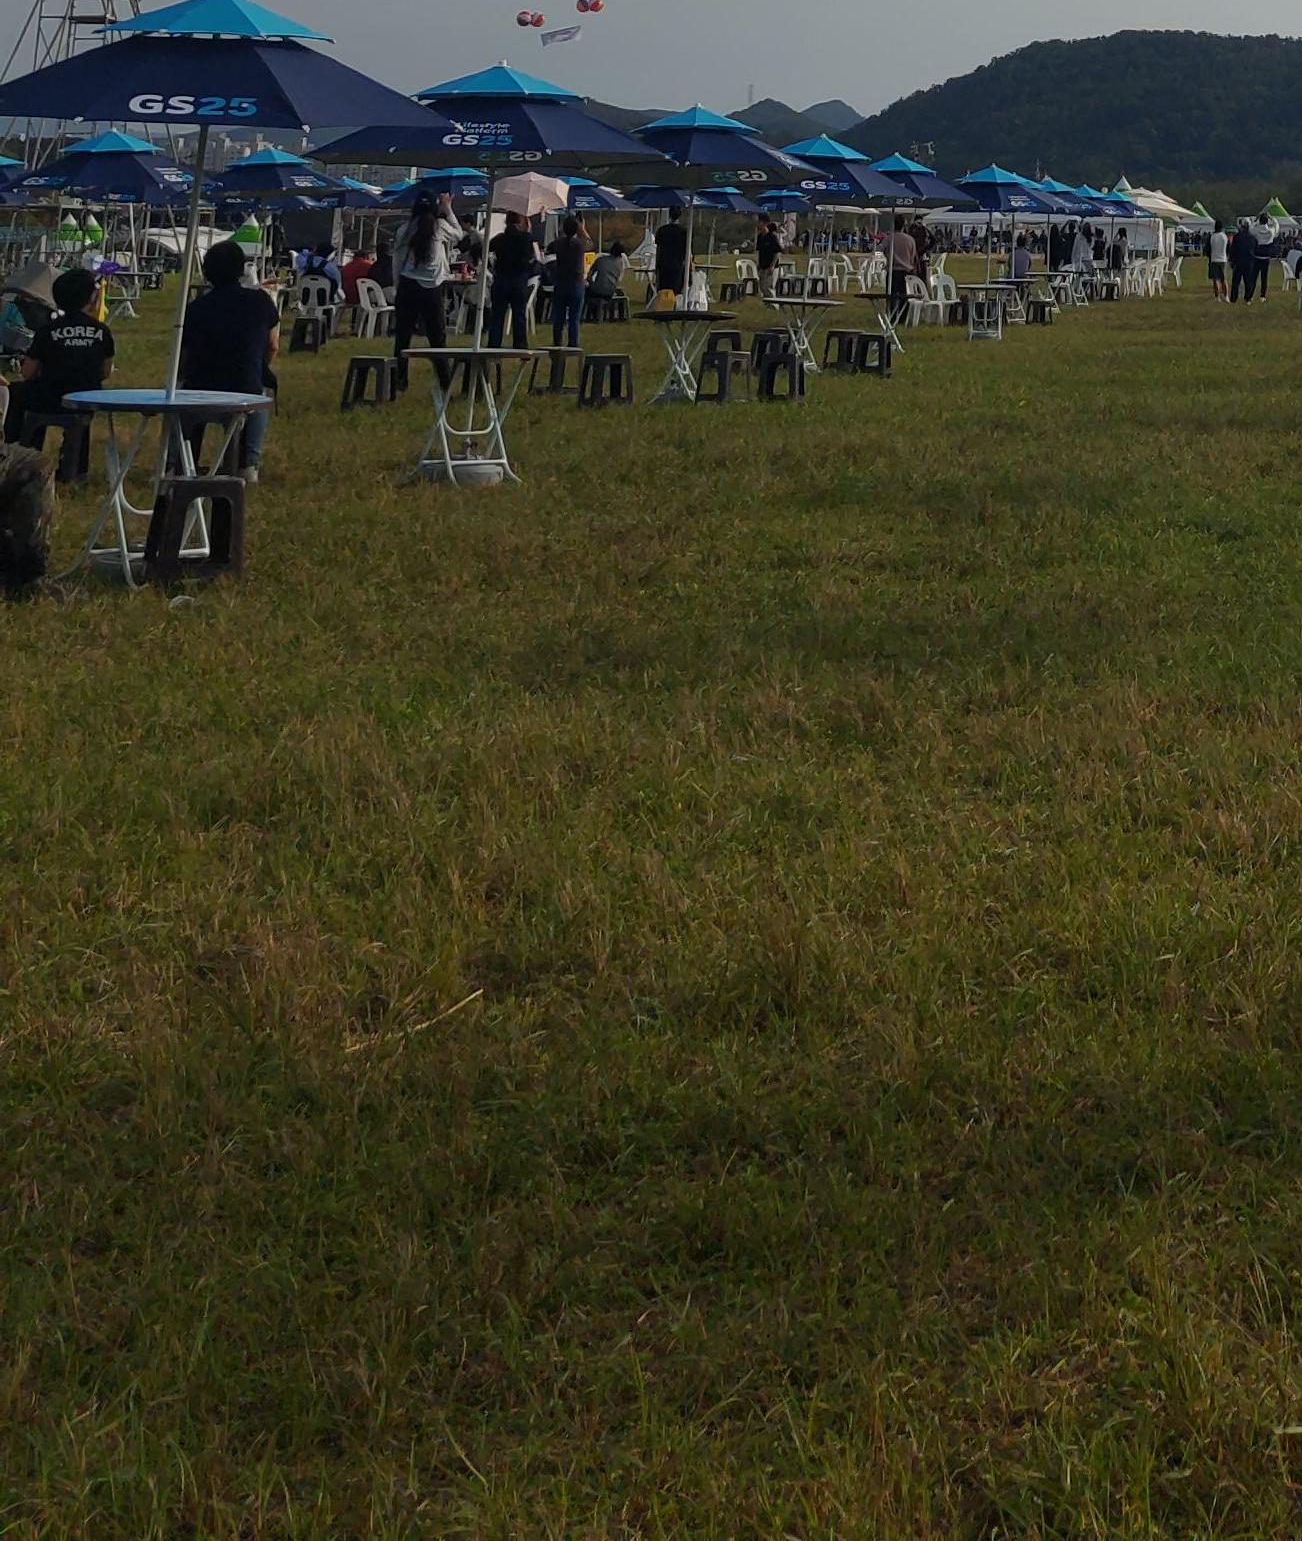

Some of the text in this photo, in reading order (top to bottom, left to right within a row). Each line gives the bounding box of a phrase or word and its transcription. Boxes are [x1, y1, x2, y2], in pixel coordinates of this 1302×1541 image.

[128, 94, 257, 116] GS25
[442, 134, 512, 146] GS25
[800, 180, 850, 191] GS25
[51, 326, 103, 341] KOREA
[64, 338, 94, 347] ARMY
